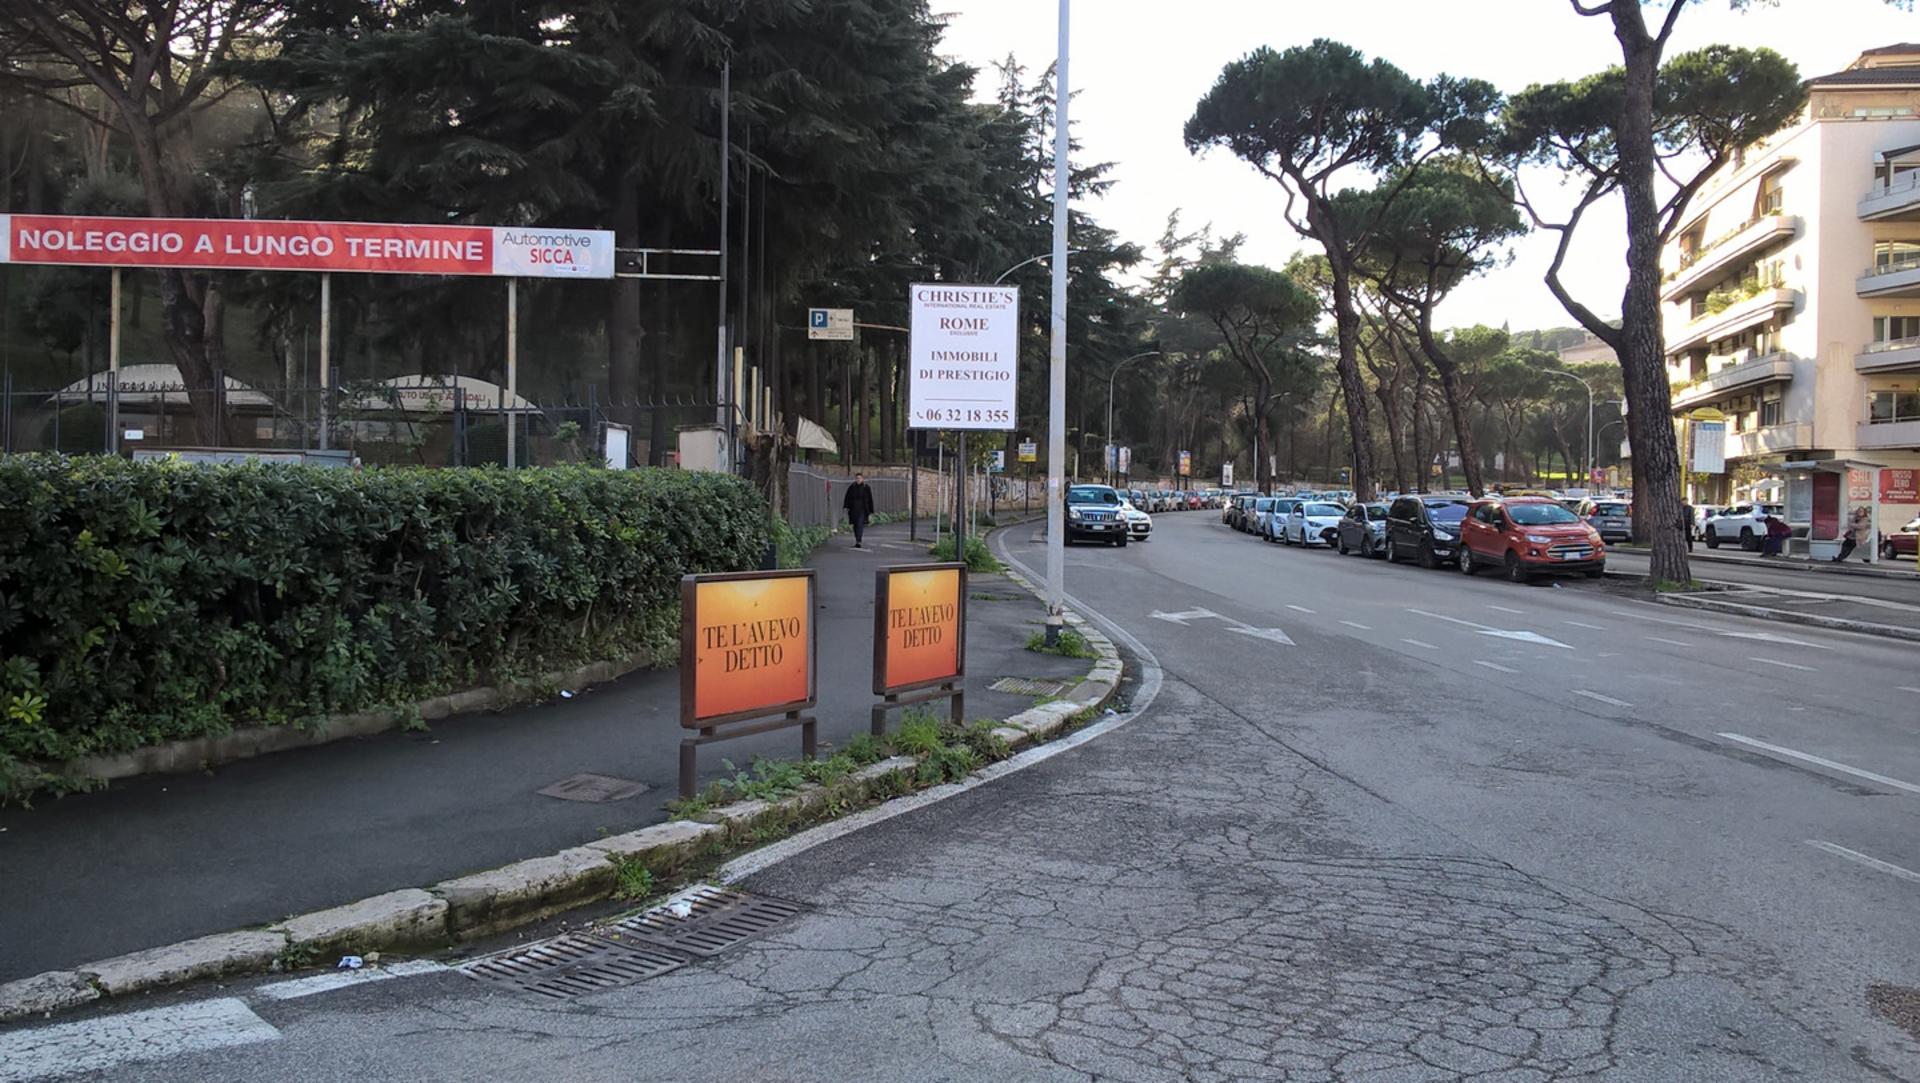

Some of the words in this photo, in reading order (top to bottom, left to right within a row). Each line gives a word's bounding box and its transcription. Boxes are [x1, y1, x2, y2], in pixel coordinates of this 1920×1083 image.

[19, 229, 184, 254] NOLEGGIO
[193, 234, 214, 254] A
[225, 234, 334, 257] LUNGO
[345, 238, 483, 261] TERMINE
[502, 232, 592, 248] Automotive
[530, 248, 574, 264] SICCA
[918, 290, 1013, 304] CHRISTIE'S
[940, 317, 989, 330] ROME
[931, 350, 998, 362] IMMOBILI
[920, 369, 933, 380] DI
[938, 369, 1010, 381] PRESTIGIO
[926, 408, 942, 421] 06
[945, 408, 961, 422] 32
[967, 409, 982, 422] 18
[985, 409, 1009, 423] 355
[890, 608, 906, 629] TE
[909, 603, 954, 627] L'AVEVO
[703, 625, 728, 650] TE
[732, 616, 800, 646] L'AVEVO
[903, 625, 942, 649] DETTO
[725, 643, 783, 673] DETTO
